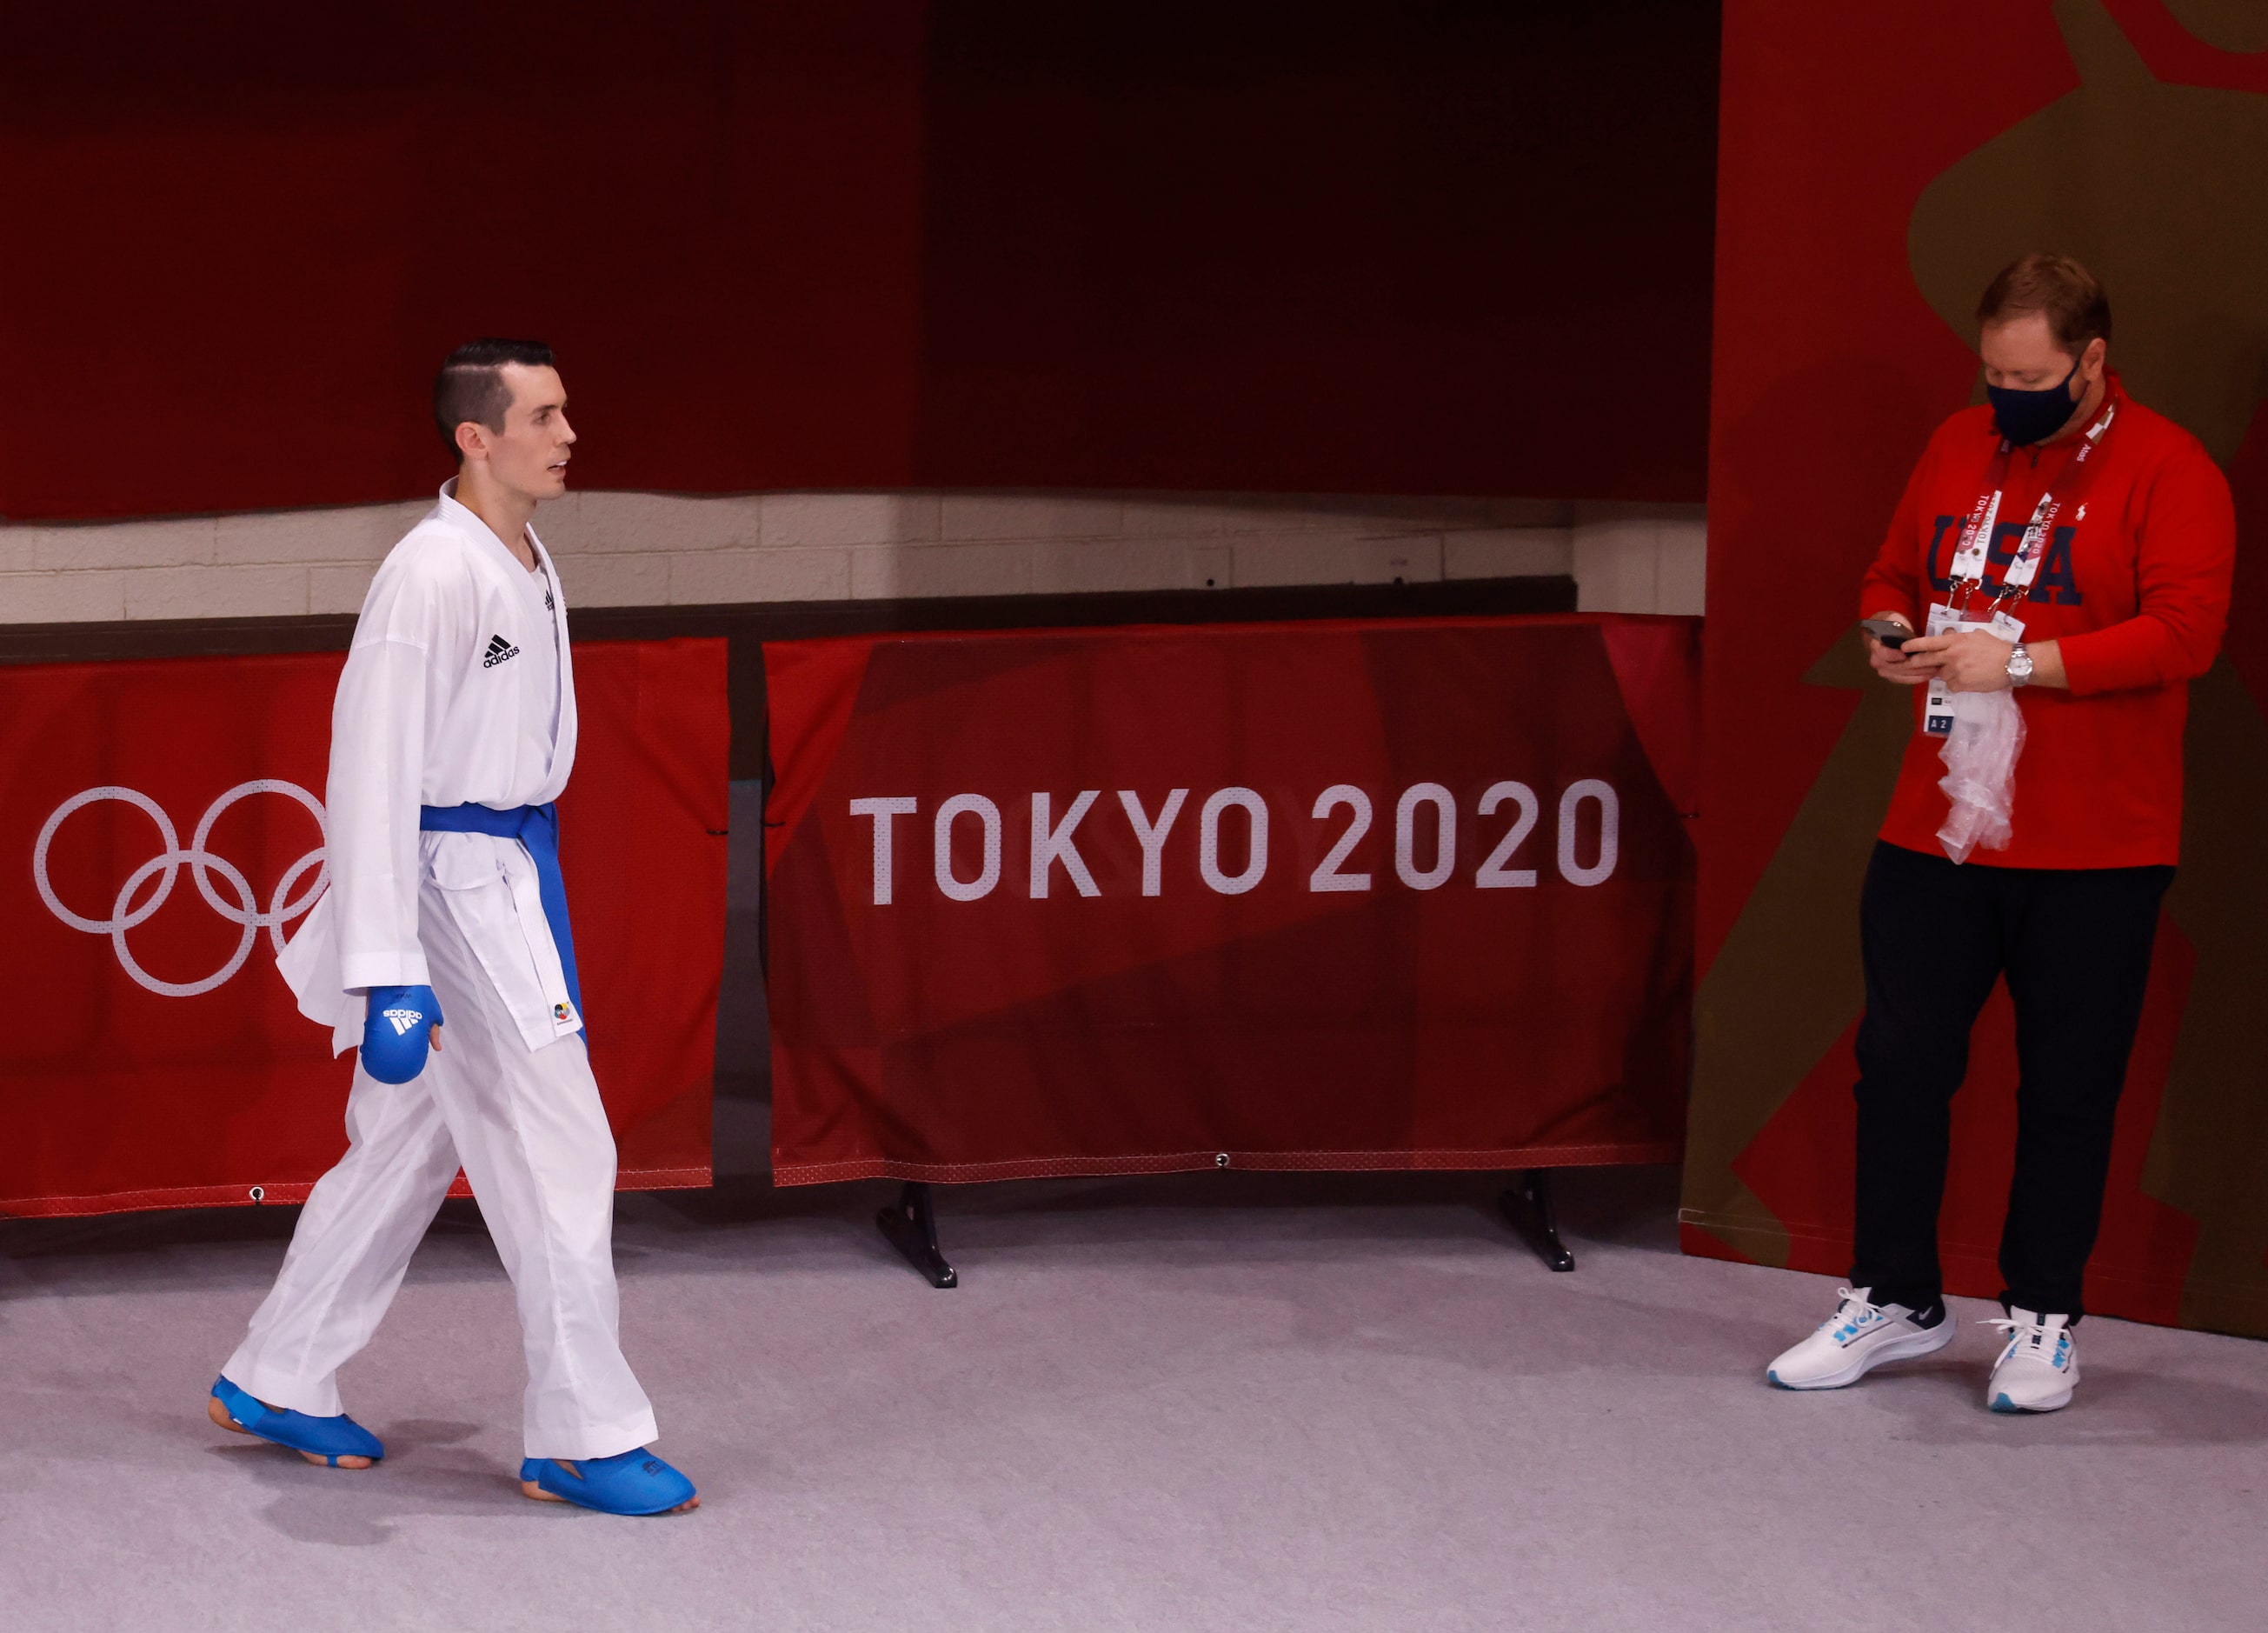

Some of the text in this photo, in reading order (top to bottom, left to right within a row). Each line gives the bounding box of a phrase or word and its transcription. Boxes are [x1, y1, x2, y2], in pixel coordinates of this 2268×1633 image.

[1927, 515, 2082, 606] USA
[483, 646, 520, 669] adidas
[850, 779, 1620, 905] TOKYO 2020
[382, 1009, 423, 1020] adidas
